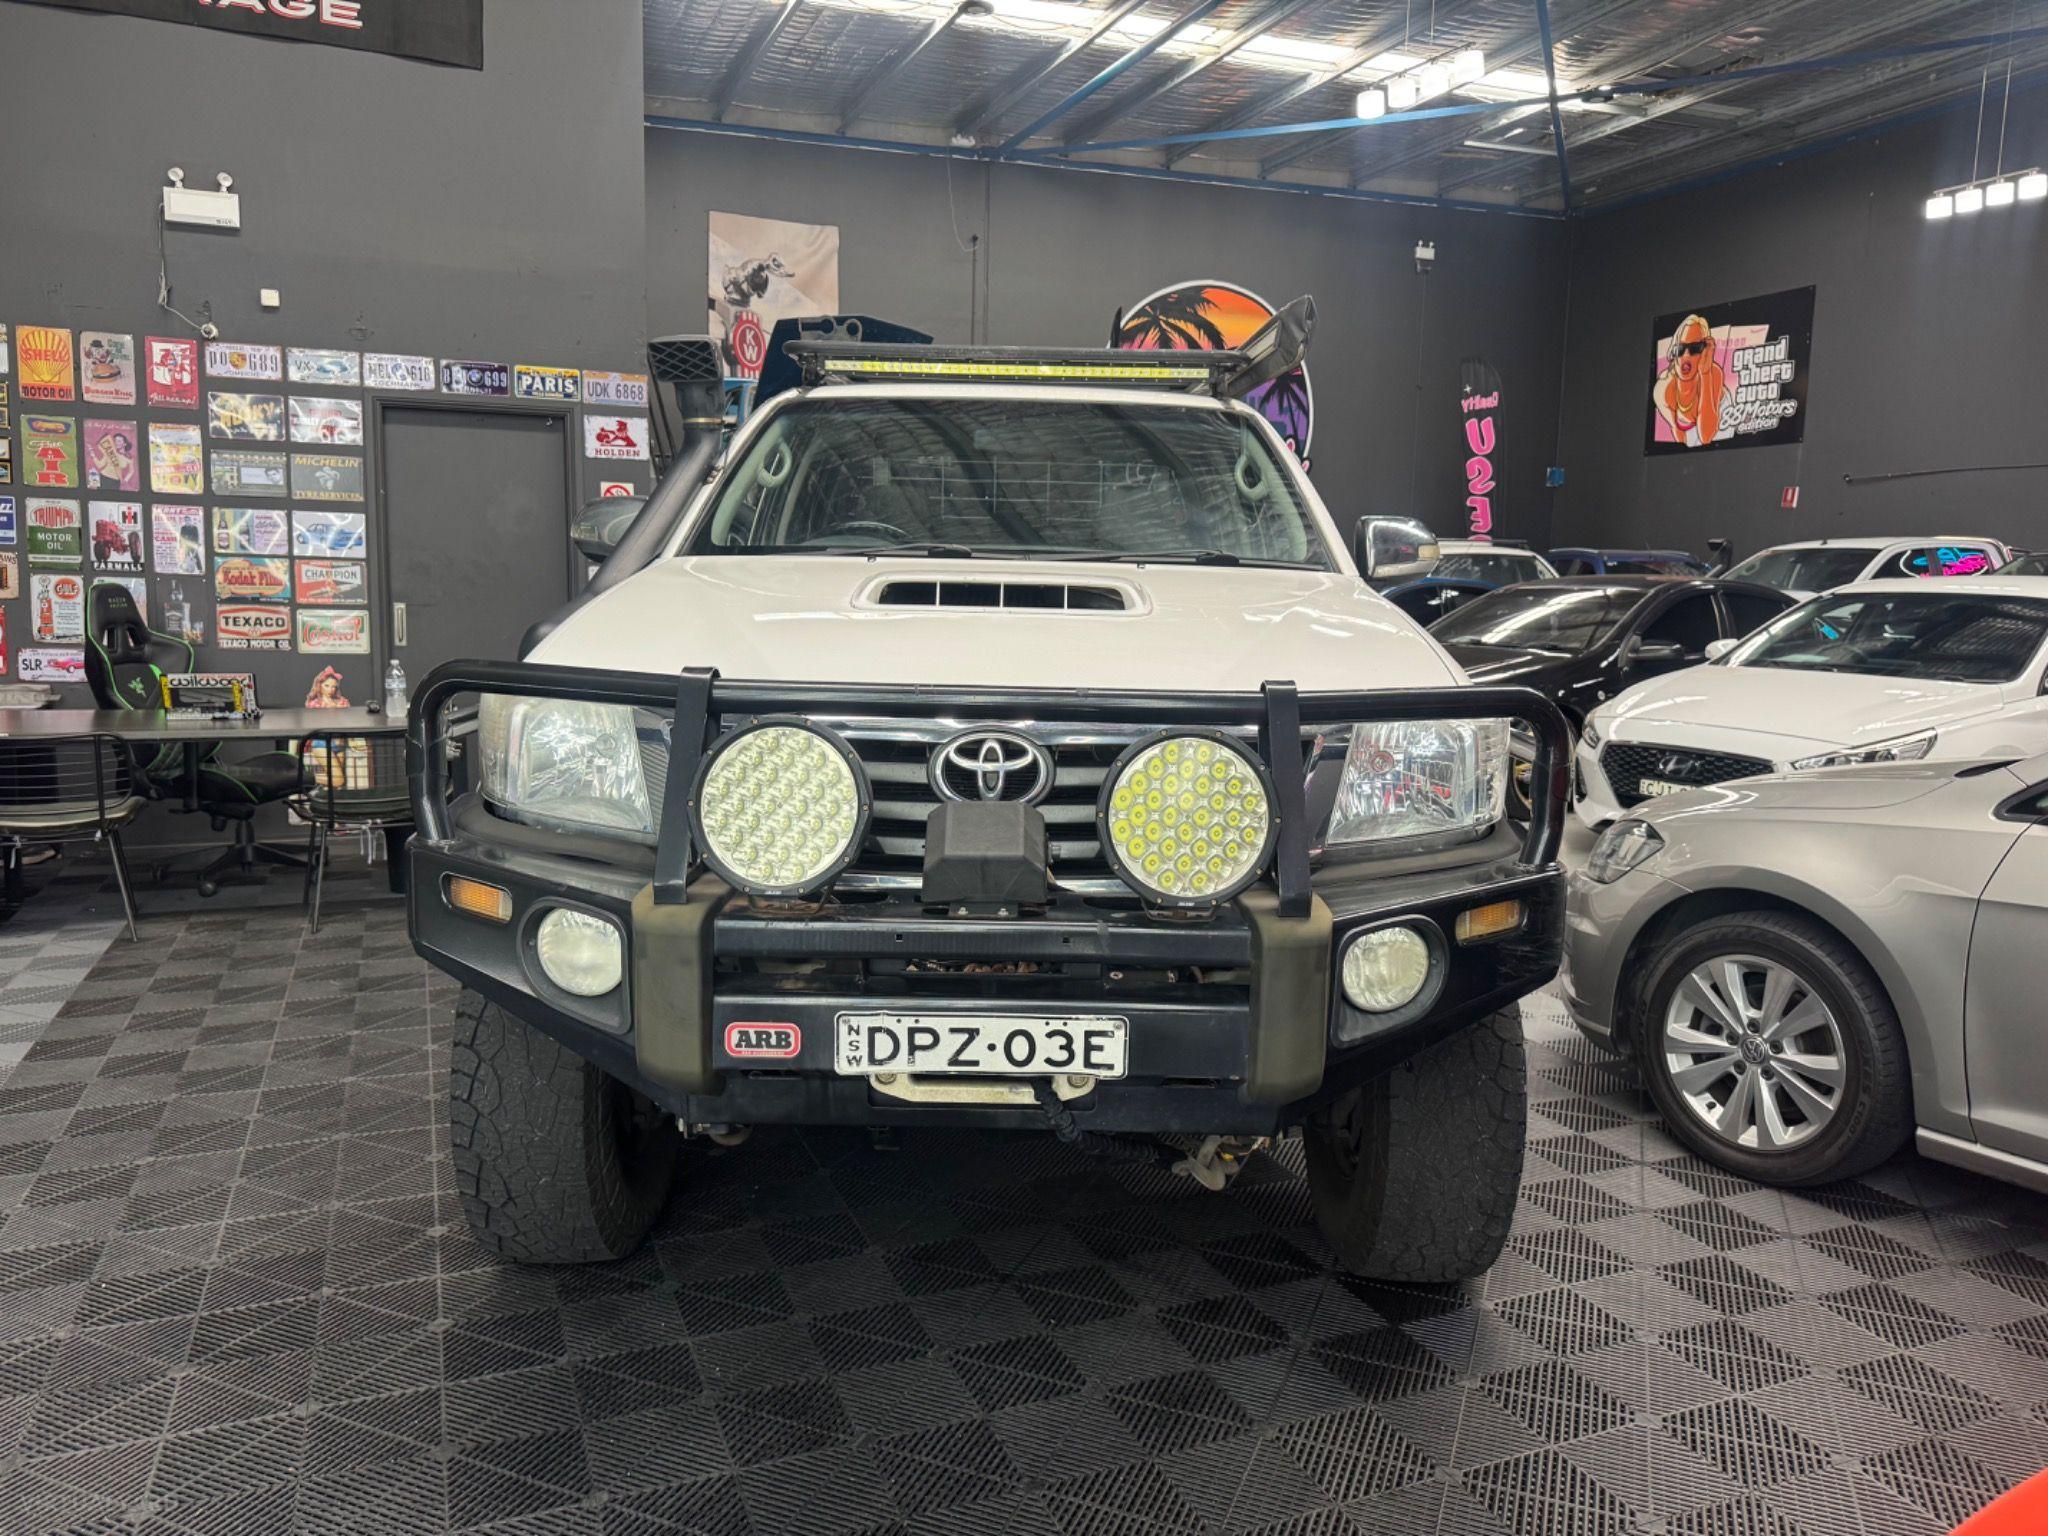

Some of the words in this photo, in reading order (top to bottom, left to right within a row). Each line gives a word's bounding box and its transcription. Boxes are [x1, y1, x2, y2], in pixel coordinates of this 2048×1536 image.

[24, 348, 66, 362] SHELL
[249, 353, 278, 372] 689
[484, 371, 507, 387] 699
[521, 375, 574, 393] PARIS
[22, 386, 55, 397] MOTOR
[58, 388, 72, 399] OIL
[587, 381, 610, 398] UDK
[615, 384, 644, 400] 6868
[1736, 382, 1780, 403] auto
[1737, 416, 1779, 433] edition
[594, 448, 640, 457] HOLDEN
[295, 456, 359, 468] MICHELIN
[34, 507, 74, 528] TRIUMPH
[37, 533, 72, 542] MOTOR
[47, 542, 63, 550] OIL
[94, 562, 143, 571] FARMALL
[223, 570, 256, 586] Kodak
[257, 570, 283, 586] Film
[304, 569, 358, 580] CHAMPION
[56, 584, 79, 595] GULF
[222, 616, 286, 628] TEXACO
[304, 617, 361, 647] Castrol
[218, 639, 248, 649] TEXACO
[250, 640, 276, 649] MOTOR
[22, 659, 42, 671] SLR
[735, 1030, 792, 1049] ARB
